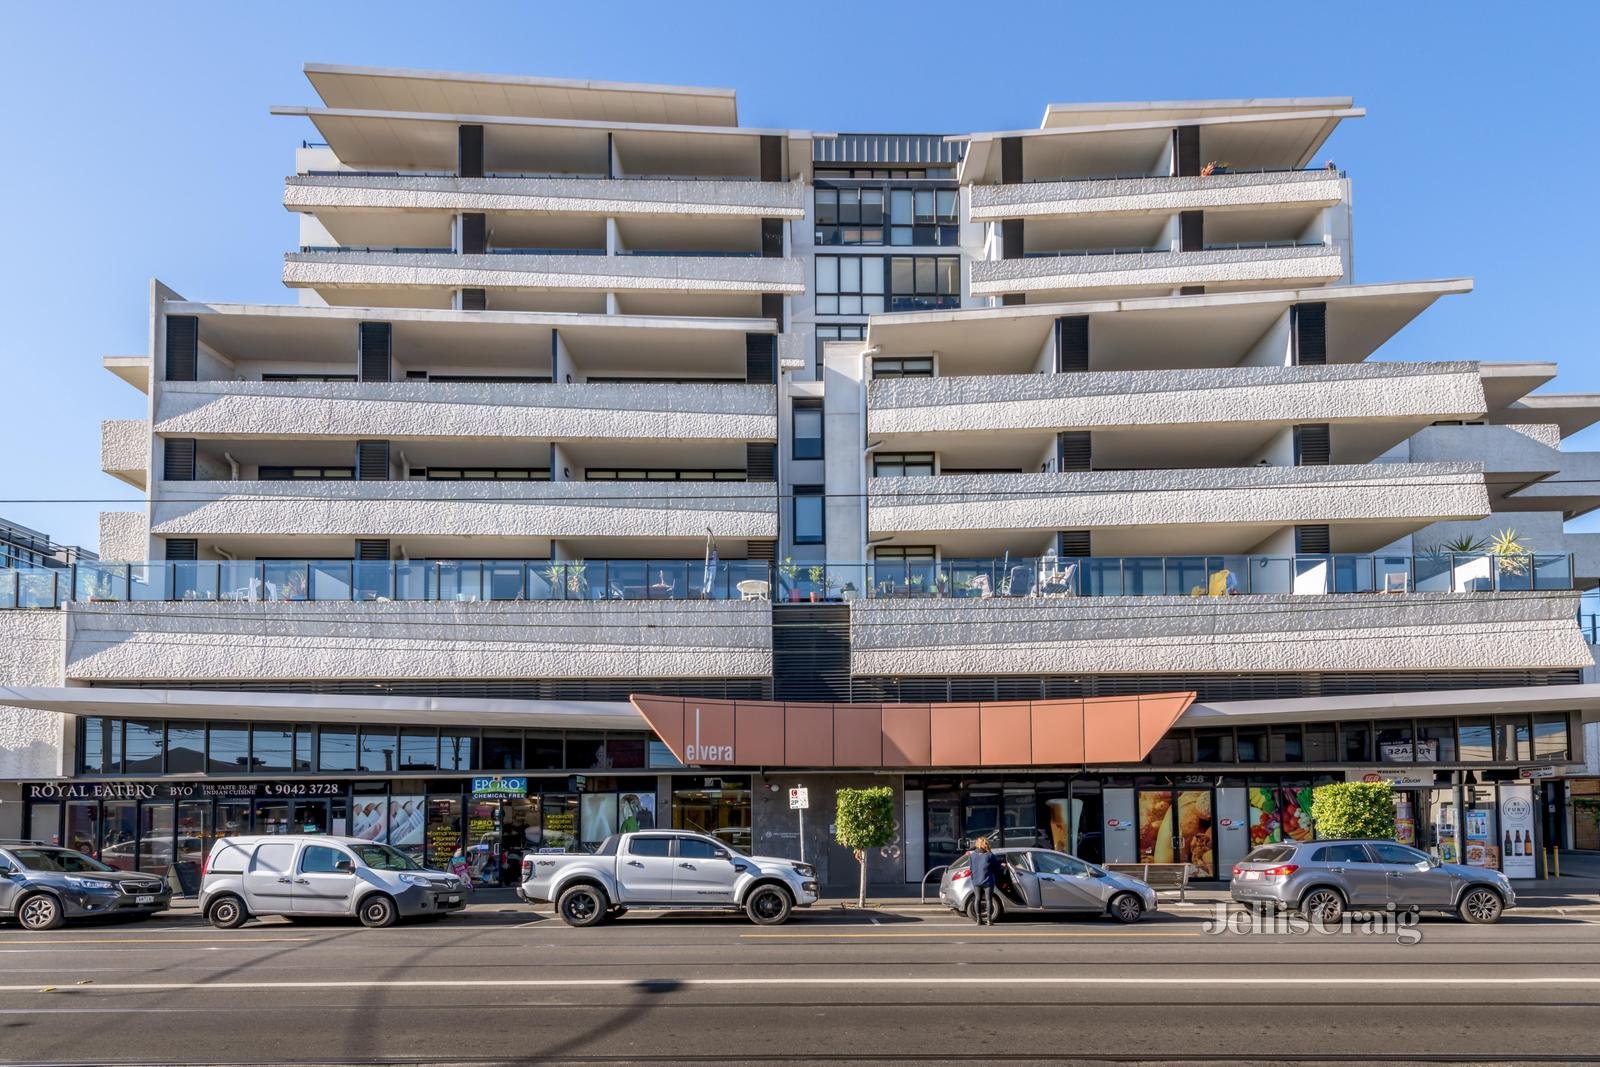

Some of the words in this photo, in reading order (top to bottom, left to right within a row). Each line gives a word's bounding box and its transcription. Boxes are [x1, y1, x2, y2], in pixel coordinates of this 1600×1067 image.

[687, 708, 733, 761] elvera
[30, 785, 89, 798] ROYAL
[94, 785, 159, 798] EATERY
[170, 786, 193, 796] BYO
[275, 784, 306, 795] 9042
[308, 783, 339, 794] 3728
